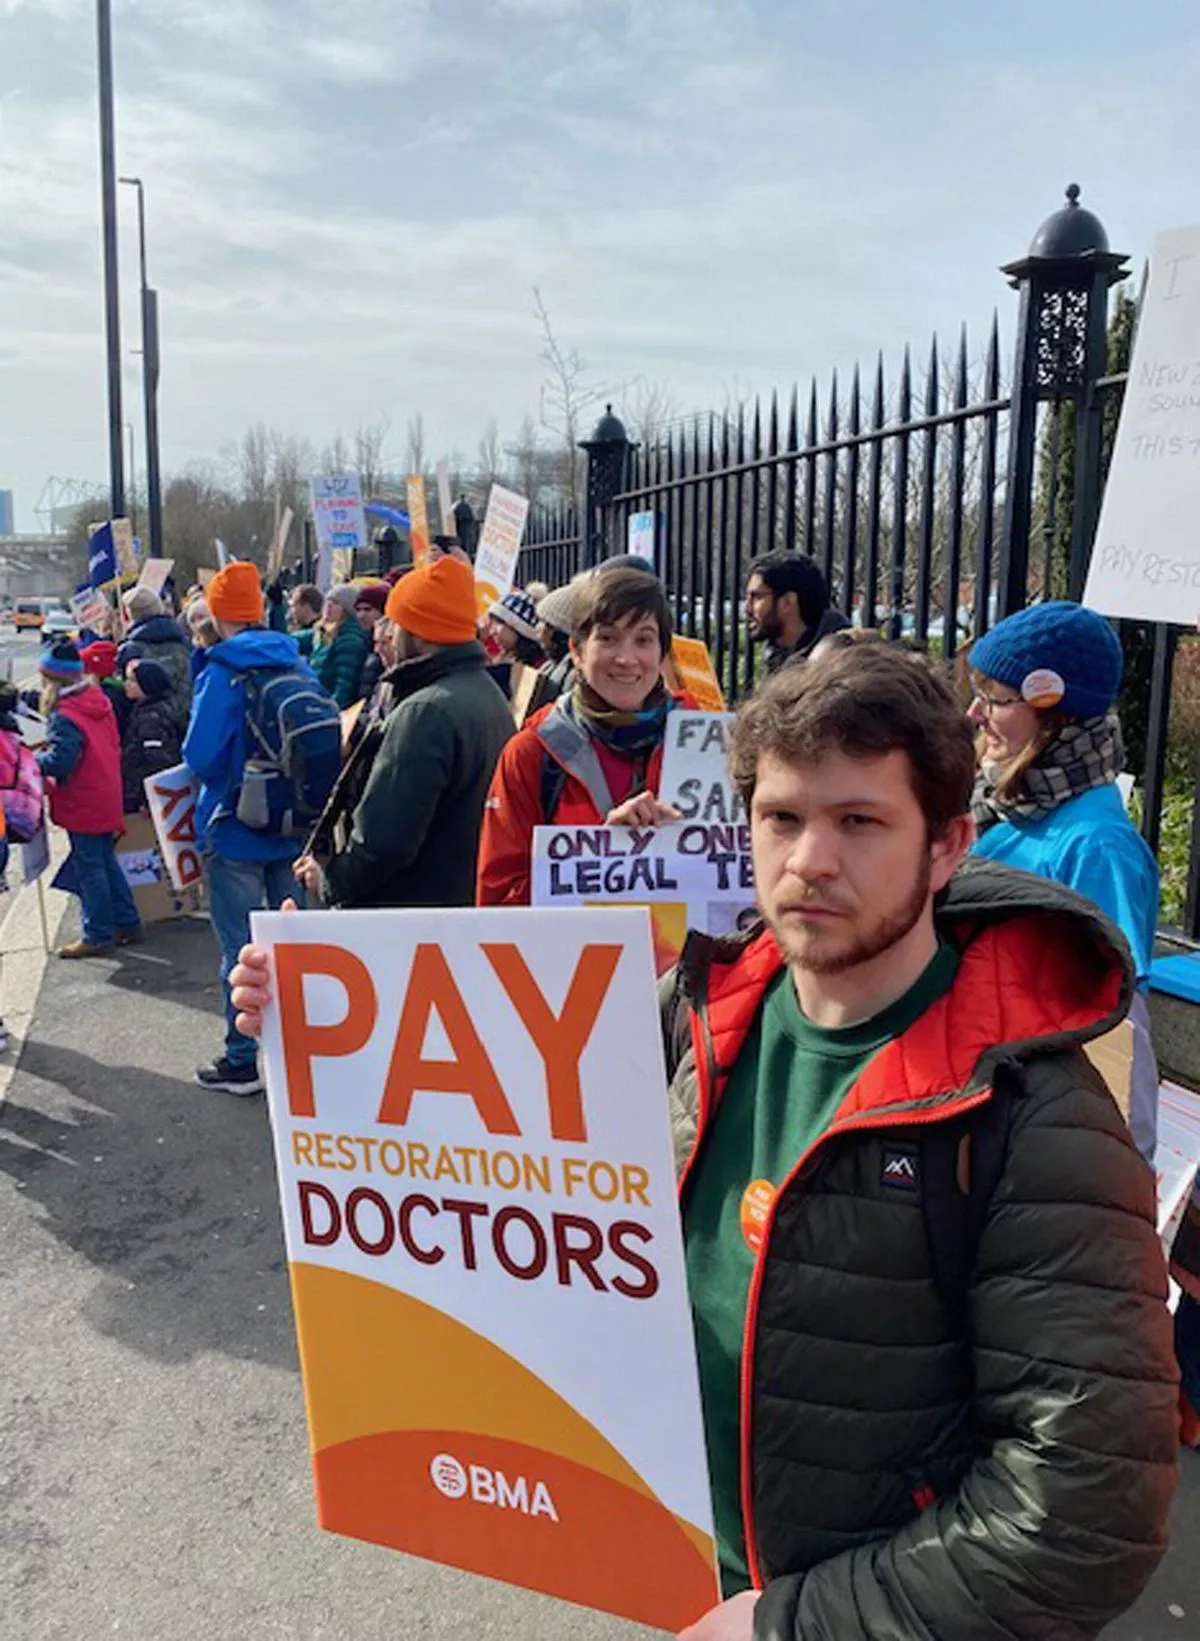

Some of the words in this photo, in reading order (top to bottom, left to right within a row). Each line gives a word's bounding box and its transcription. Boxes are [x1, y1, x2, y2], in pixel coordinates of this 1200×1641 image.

[1139, 360, 1189, 387] NEW
[1131, 432, 1184, 462] THIS
[676, 717, 728, 753] FA
[153, 784, 202, 885] PAY
[548, 826, 655, 860] ONLY
[677, 824, 752, 855] ONE
[550, 856, 677, 896] LEGAL
[273, 943, 624, 1142] PAY
[291, 1131, 550, 1194] RESTORATION
[564, 1157, 650, 1206] FOR
[297, 1180, 660, 1299] DOCTORS
[470, 1462, 560, 1522] BMA
